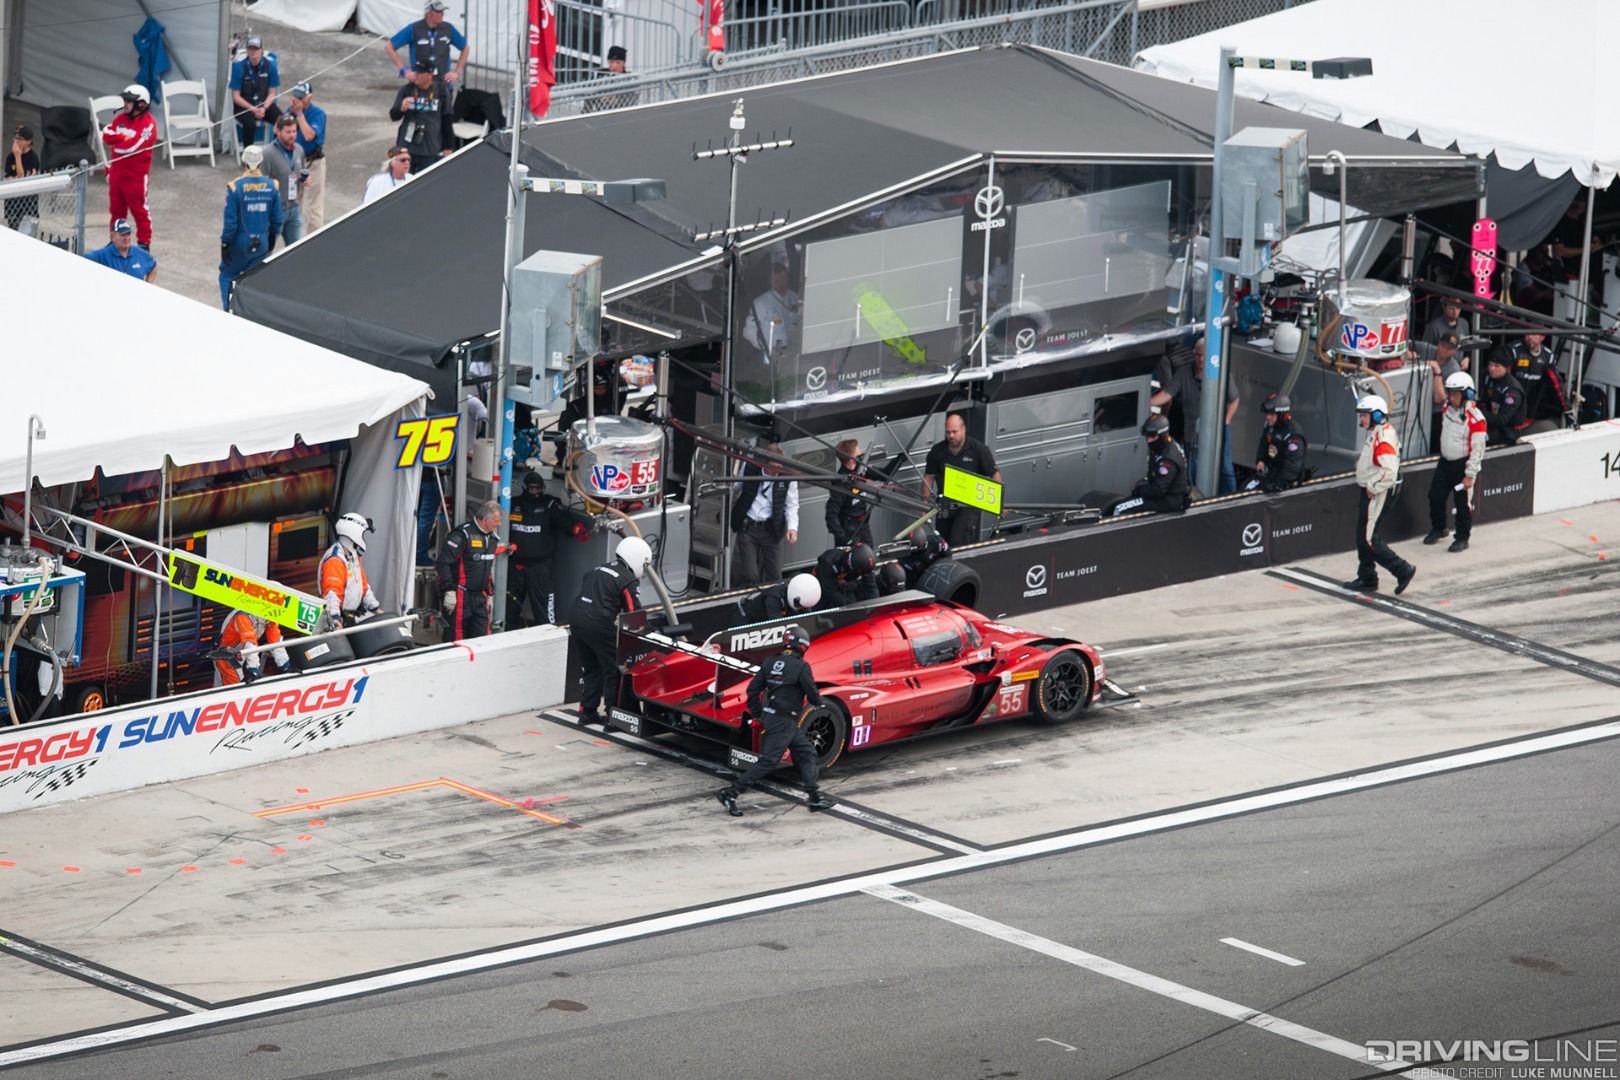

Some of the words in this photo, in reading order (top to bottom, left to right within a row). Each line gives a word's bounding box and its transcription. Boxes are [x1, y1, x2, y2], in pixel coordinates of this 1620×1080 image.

[1046, 334, 1065, 343] TEAM
[1067, 330, 1088, 340] JOEST
[1343, 323, 1368, 349] VP
[1387, 321, 1404, 343] 77
[838, 372, 857, 381] TEAM
[860, 367, 880, 378] JOEST
[395, 413, 461, 469] 75
[593, 464, 619, 490] VP
[637, 461, 656, 483] 55
[975, 482, 996, 504] 55
[1483, 487, 1502, 496] TEAM
[1504, 482, 1523, 494] JOEST
[1272, 529, 1290, 538] TEAM
[1292, 524, 1312, 535] JOEST
[172, 556, 200, 590] 75
[1056, 570, 1075, 579] TEAM
[1077, 565, 1097, 577] JOEST
[204, 568, 291, 608] SUNENERGY1
[301, 603, 317, 623] 75
[731, 624, 793, 652] mazd
[118, 676, 369, 749] SUNENERGY1
[1000, 691, 1022, 714] 55
[612, 710, 639, 725] mazda
[210, 713, 320, 754] Racing
[629, 725, 638, 733] 55
